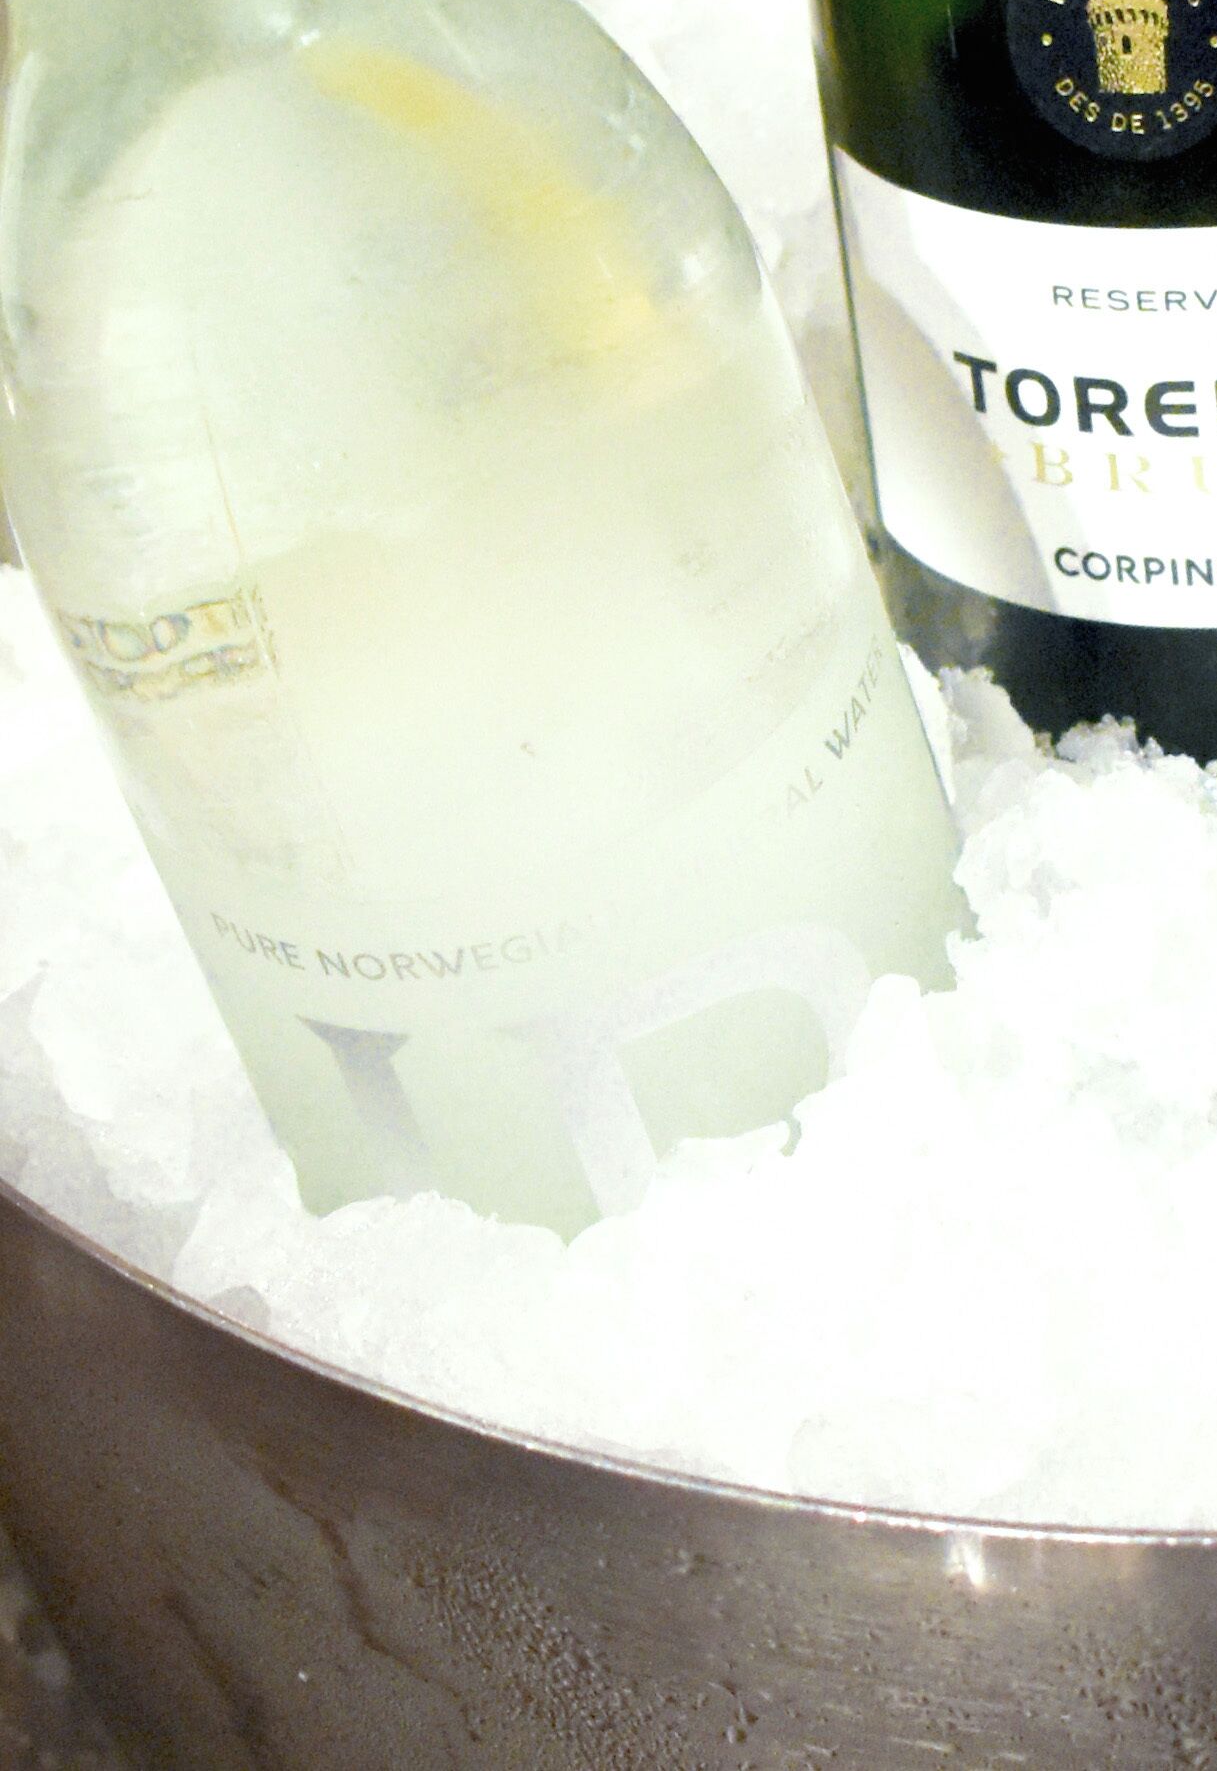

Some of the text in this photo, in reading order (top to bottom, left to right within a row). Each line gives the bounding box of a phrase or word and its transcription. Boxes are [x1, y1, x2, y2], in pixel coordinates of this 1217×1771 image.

[1054, 76, 1216, 136] DES DE 1395
[209, 910, 308, 974] PURE
[314, 918, 588, 984] NORWEGIA
